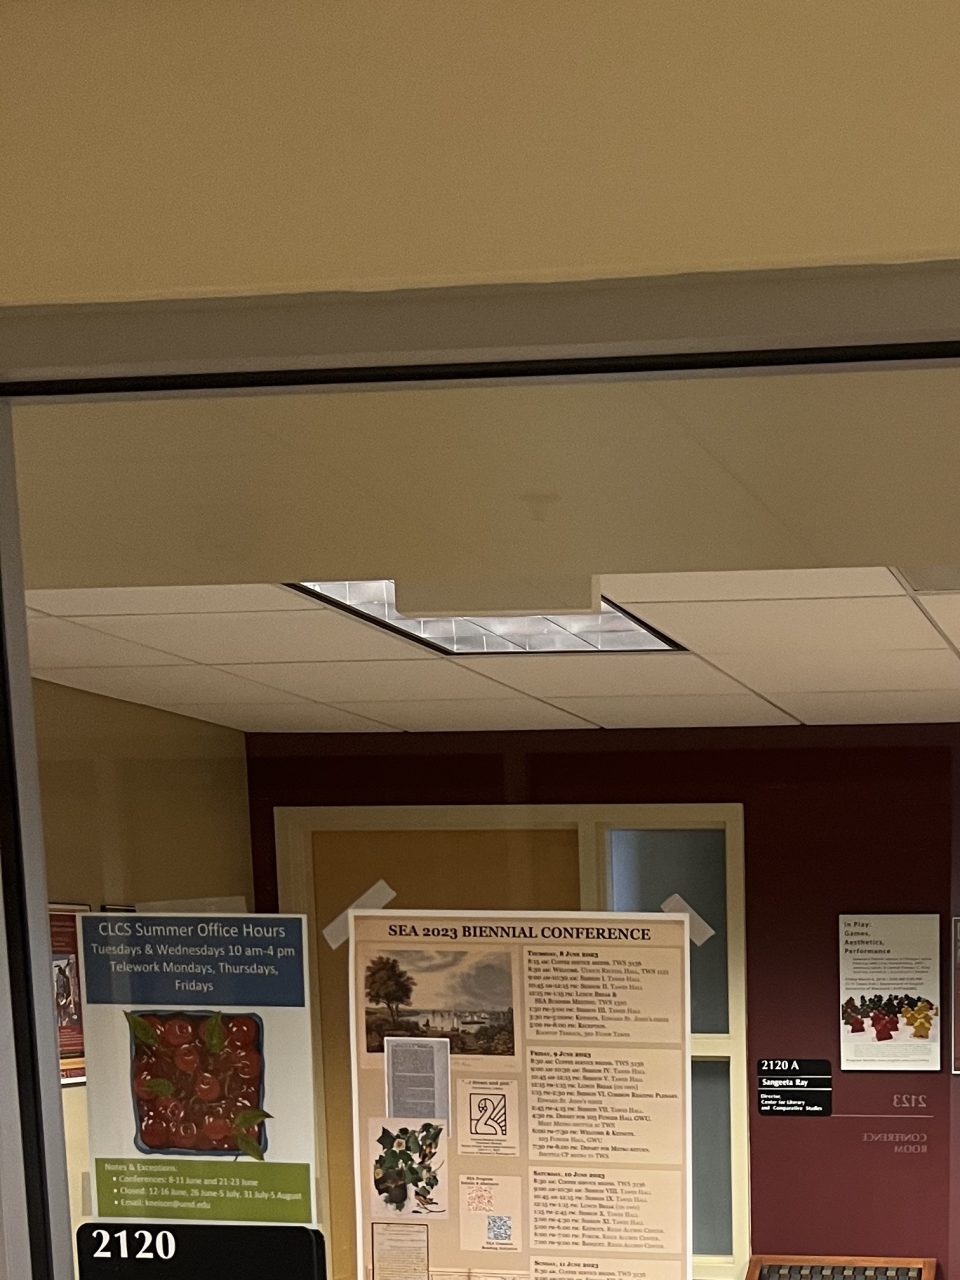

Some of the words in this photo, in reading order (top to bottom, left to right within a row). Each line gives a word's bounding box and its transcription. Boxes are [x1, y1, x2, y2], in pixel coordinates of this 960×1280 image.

[99, 923, 131, 936] CLCS
[136, 923, 192, 937] Summer
[198, 923, 238, 937] Office
[243, 924, 285, 937] Hours
[388, 925, 418, 936] SEA
[423, 927, 458, 940] 2023
[462, 926, 537, 938] BIENNIAL
[540, 927, 651, 940] CONFERENCE
[91, 944, 141, 956] Tuesdays
[145, 944, 153, 955] &
[156, 944, 225, 957] Wednesdays
[229, 945, 242, 955] 10
[245, 945, 273, 955] am-4
[277, 947, 295, 959] pm
[110, 961, 160, 973] Telework
[163, 962, 215, 975] Mondays,
[219, 963, 279, 976] Thursdays,
[175, 980, 214, 992] Fridays
[762, 1060, 788, 1070] 2120
[791, 1060, 799, 1070] A
[762, 1079, 793, 1087] Sangeeta
[796, 1079, 808, 1087] Ray
[92, 1229, 176, 1260] 2120
